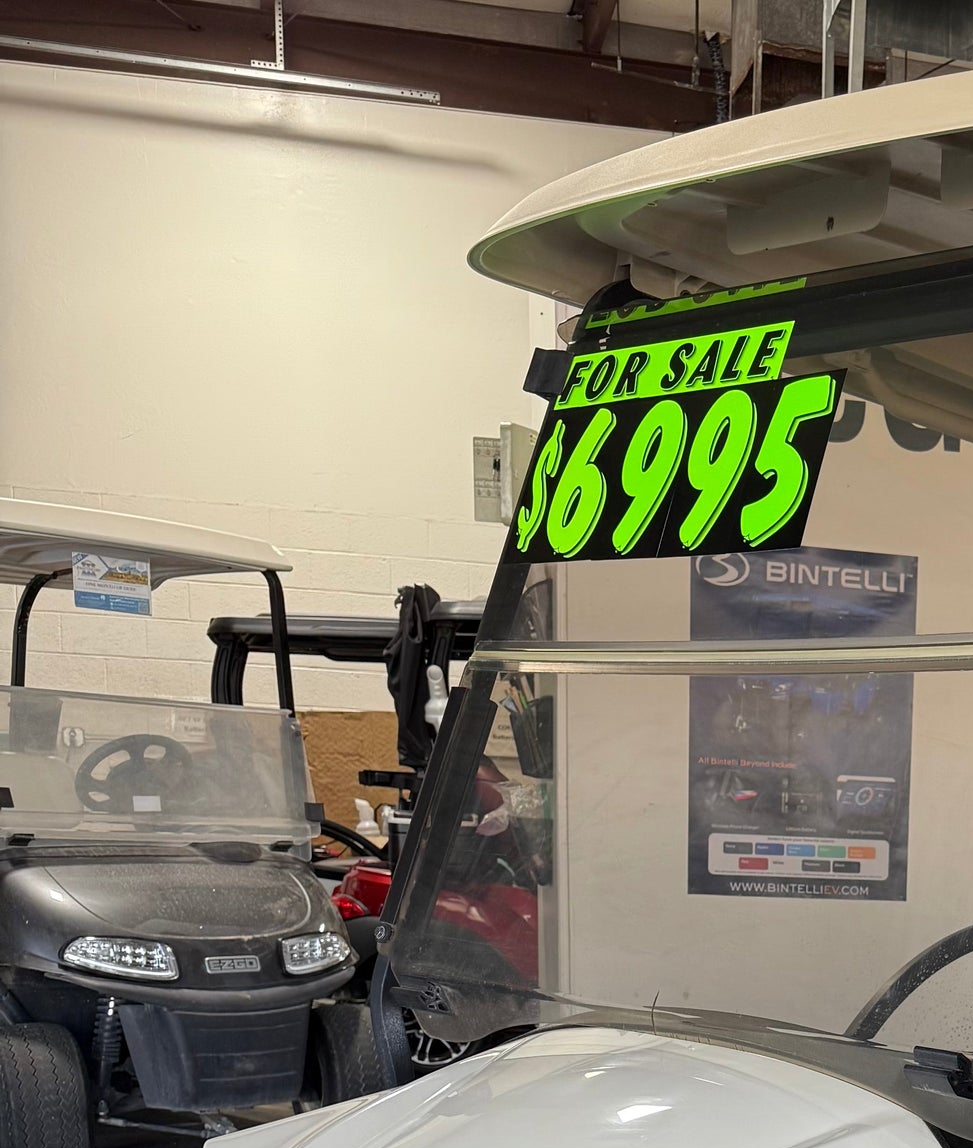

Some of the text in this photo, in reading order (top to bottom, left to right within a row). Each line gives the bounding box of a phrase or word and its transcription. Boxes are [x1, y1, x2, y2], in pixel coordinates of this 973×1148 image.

[559, 329, 787, 405] FOR SALE
[516, 374, 836, 558] $6995
[766, 561, 905, 593] BINTELLI
[729, 881, 869, 896] WWW.BINTELLIEV.COM
